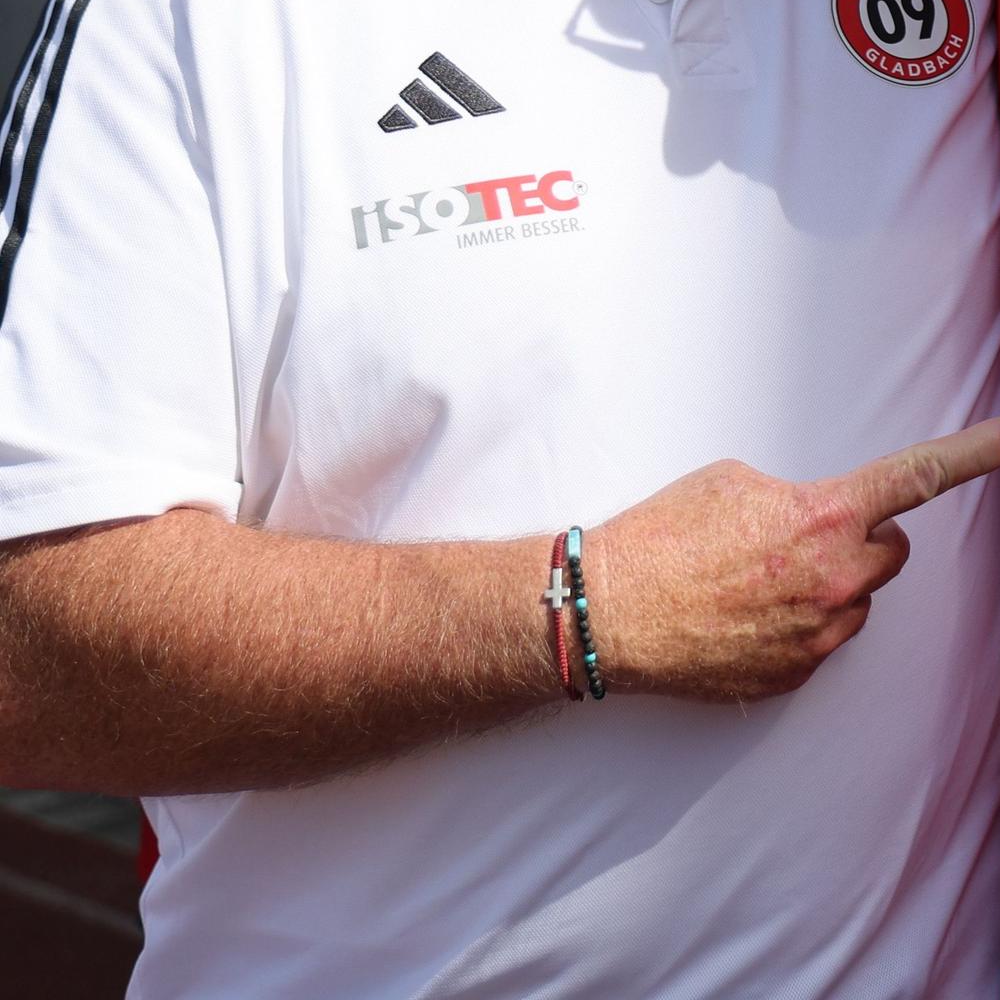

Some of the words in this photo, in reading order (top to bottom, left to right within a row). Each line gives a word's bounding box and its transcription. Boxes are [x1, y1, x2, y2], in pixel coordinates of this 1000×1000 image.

[865, 33, 964, 77] GLADBACH
[456, 225, 516, 249] IMMER
[522, 217, 585, 239] BESSER.
